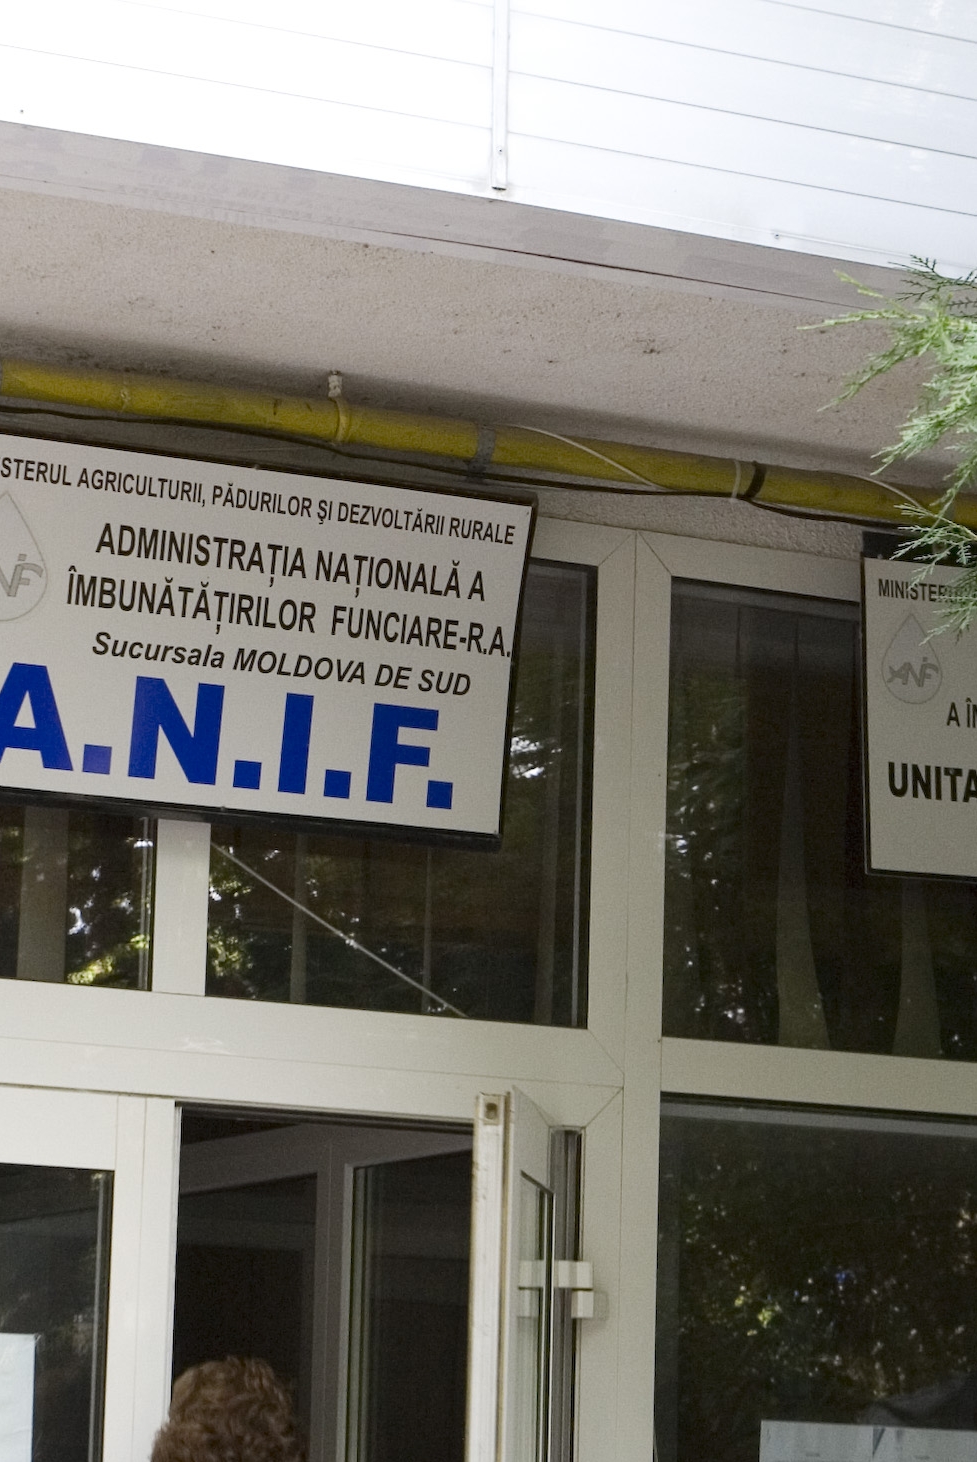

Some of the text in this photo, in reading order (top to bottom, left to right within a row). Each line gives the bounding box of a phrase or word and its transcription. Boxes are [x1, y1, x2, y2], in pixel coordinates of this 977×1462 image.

[77, 467, 206, 507] AGRICULTURII,
[212, 483, 312, 518] PĂDURILOR
[338, 502, 445, 536] DEZVOLTĂRII
[449, 519, 516, 545] RURALE
[467, 571, 485, 602] A
[331, 605, 511, 657] FUNCIARE-R.A.
[92, 631, 471, 696] Sucursala MOLDOVA DE SUD
[946, 702, 960, 728] A
[888, 761, 977, 803] UNITA
